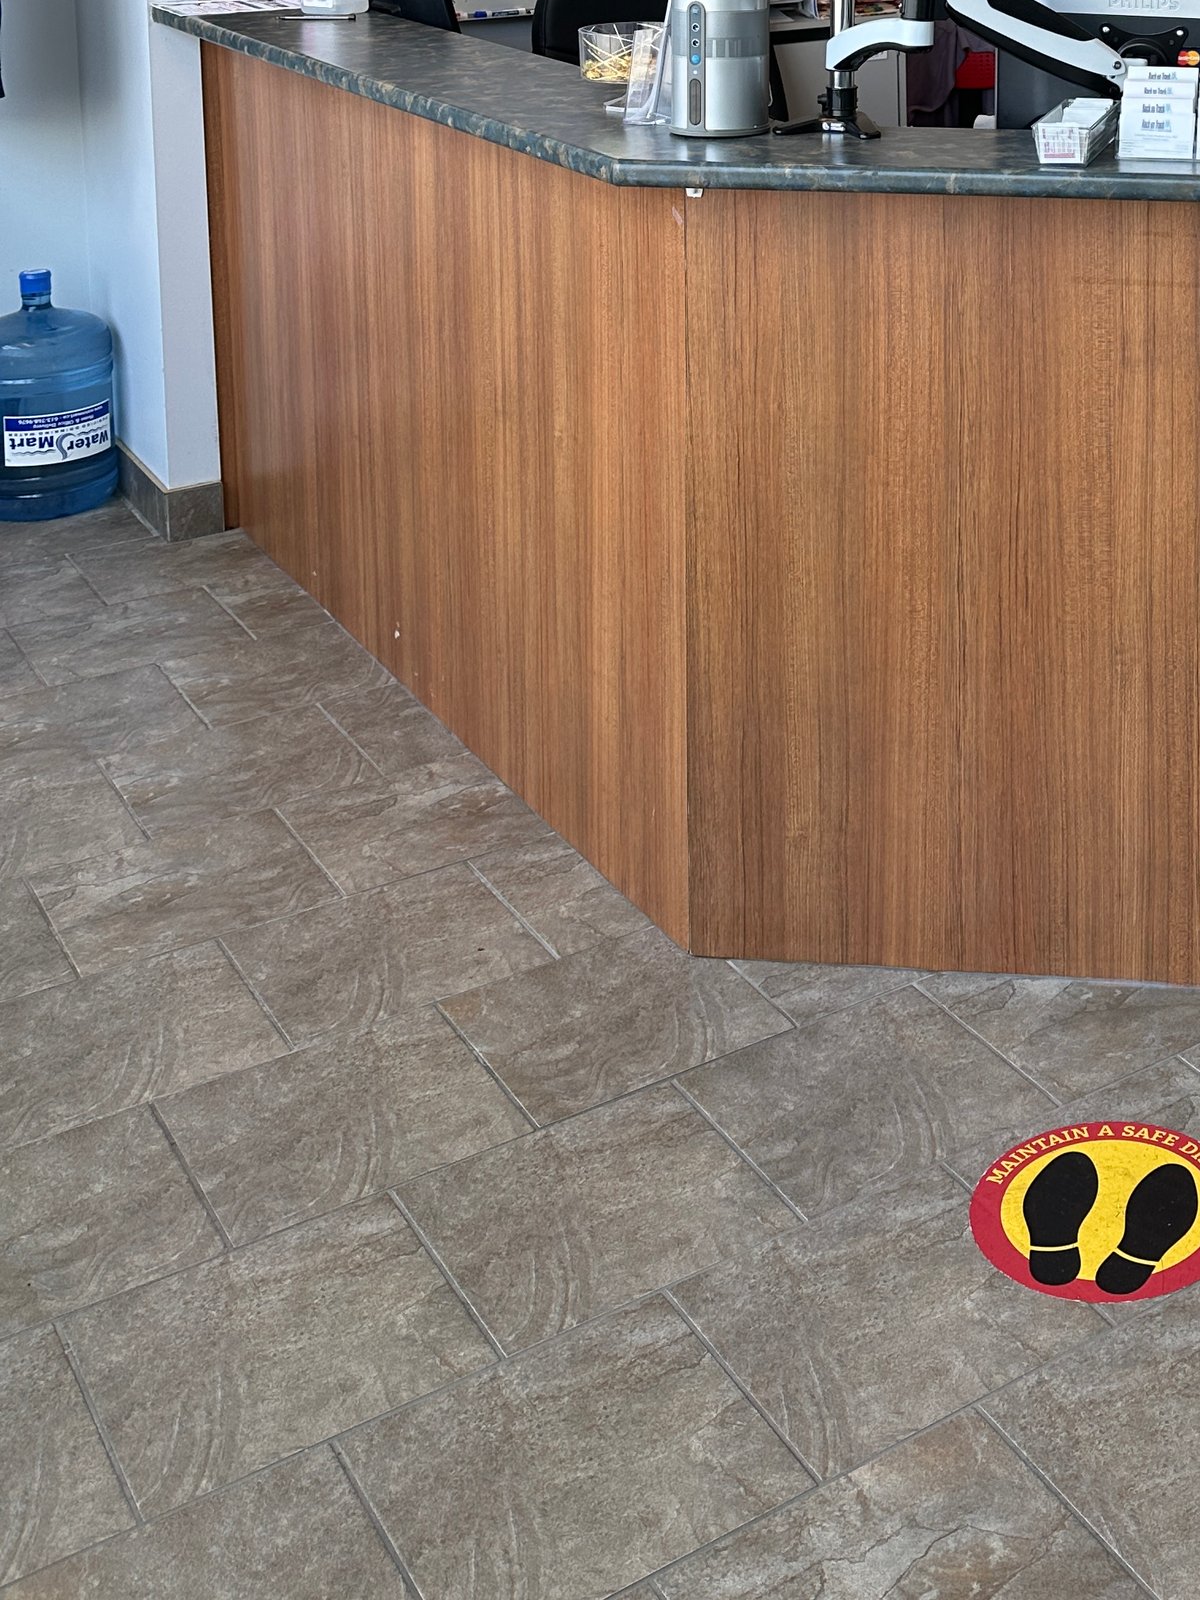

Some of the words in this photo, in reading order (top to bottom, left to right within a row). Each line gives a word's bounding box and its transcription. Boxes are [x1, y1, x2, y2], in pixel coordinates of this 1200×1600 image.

[9, 435, 54, 450] Mart
[67, 429, 109, 451] Water
[986, 1126, 1090, 1185] MAINTAIN
[1098, 1124, 1115, 1137] A
[1121, 1125, 1180, 1147] SAFE
